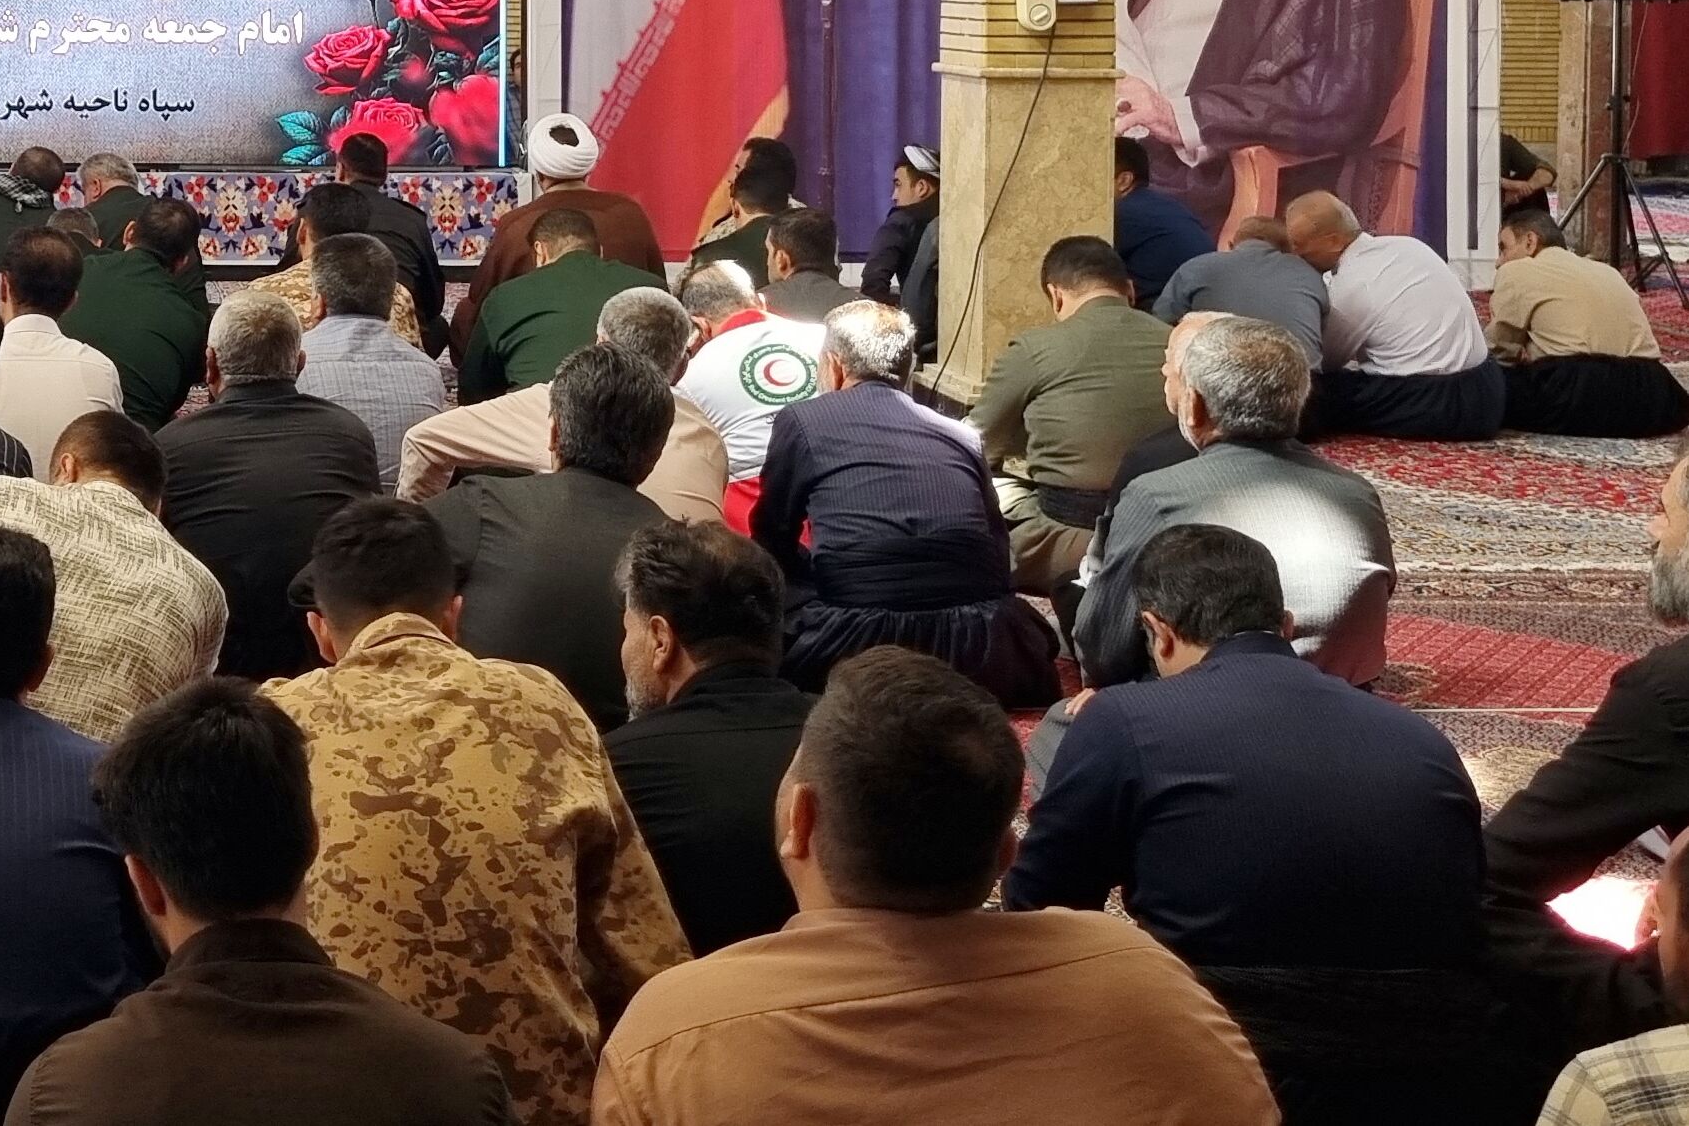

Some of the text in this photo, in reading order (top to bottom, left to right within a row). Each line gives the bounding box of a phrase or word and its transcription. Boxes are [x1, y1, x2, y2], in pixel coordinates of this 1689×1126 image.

[28, 13, 132, 55] محترم
[142, 17, 227, 55] جمعه
[238, 8, 304, 55] امام
[62, 87, 129, 122] ناحیه
[139, 87, 195, 122] سپاه
